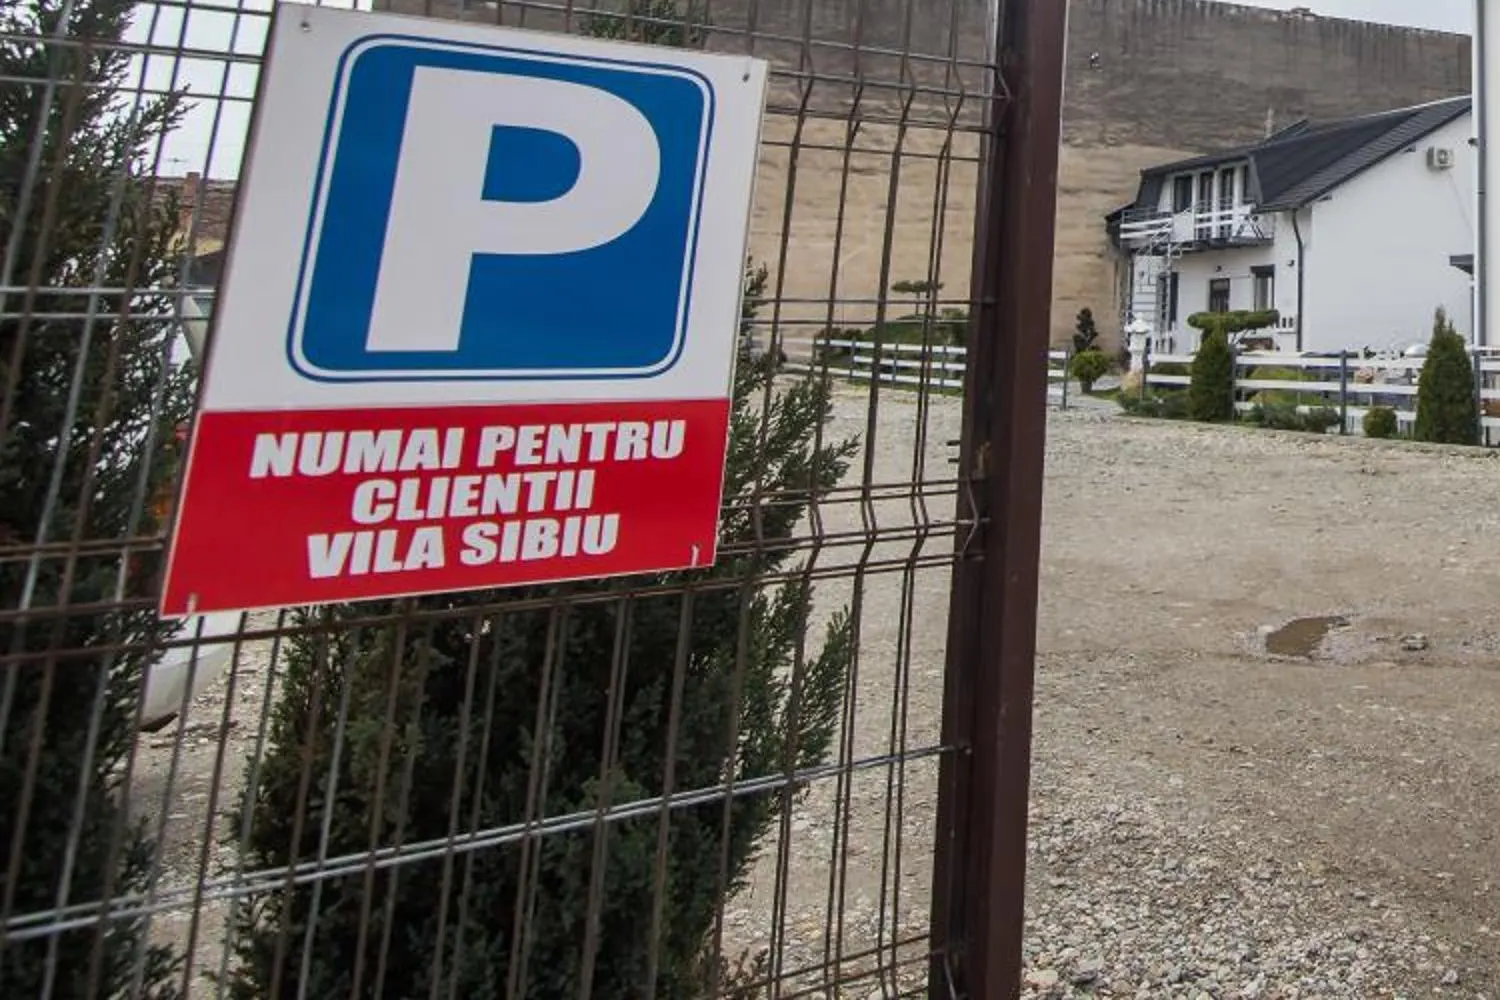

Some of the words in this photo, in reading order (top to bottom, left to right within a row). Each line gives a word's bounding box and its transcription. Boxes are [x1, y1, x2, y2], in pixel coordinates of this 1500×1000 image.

[365, 65, 661, 353] P
[249, 427, 465, 478] NUMAI
[477, 420, 686, 468] PENTRU
[352, 469, 595, 524] CLIENTII
[307, 526, 445, 578] VILA
[460, 513, 620, 565] SIBIU
